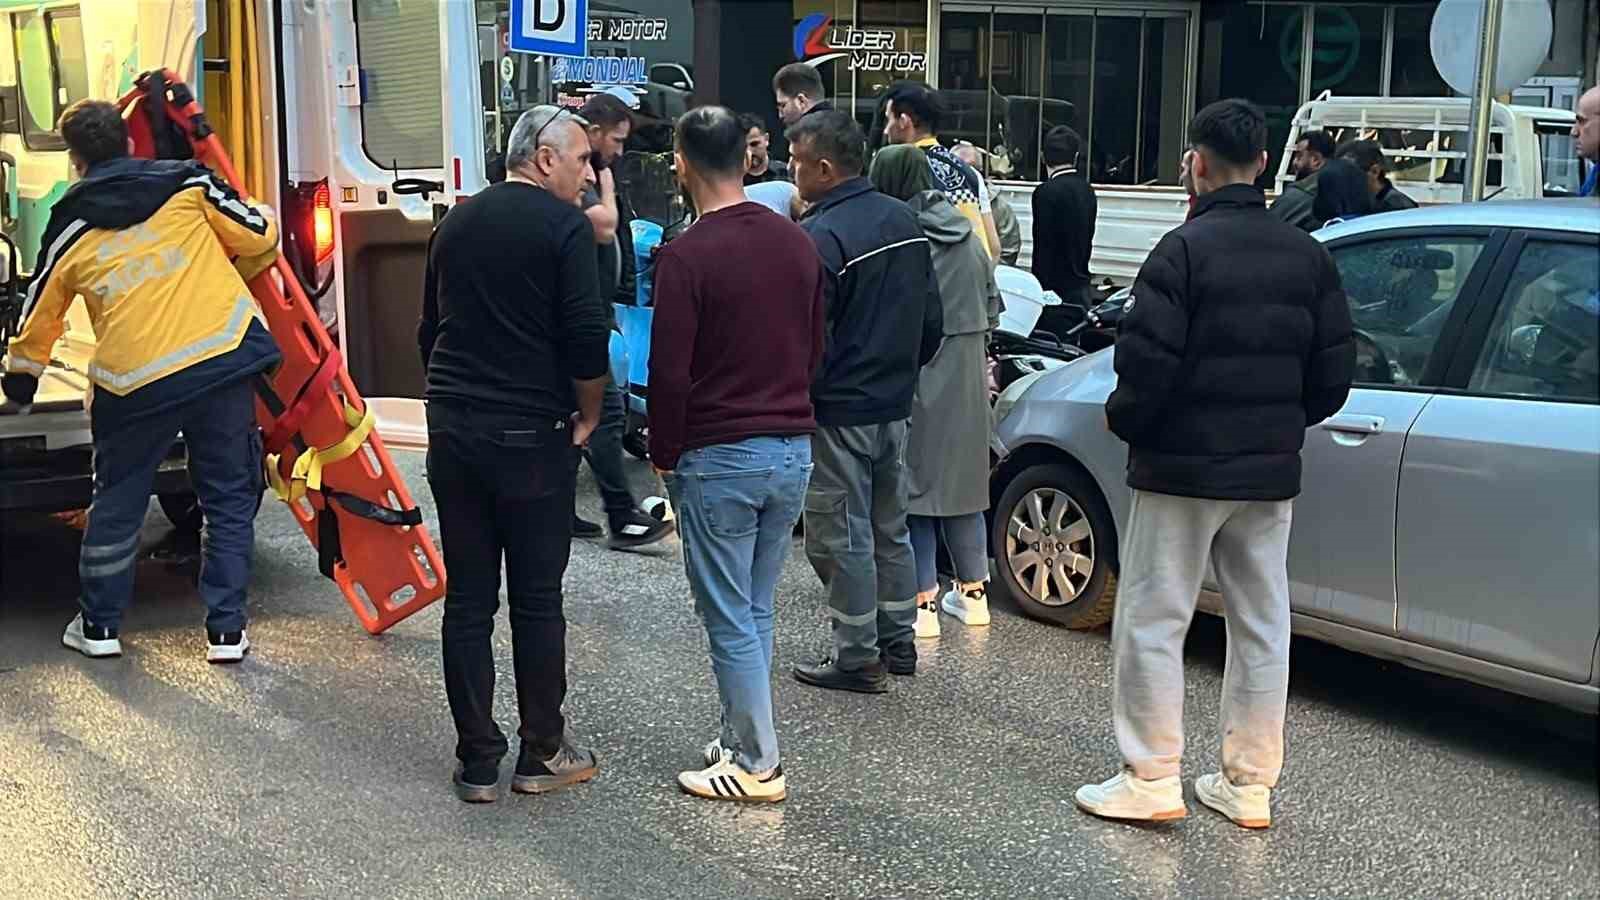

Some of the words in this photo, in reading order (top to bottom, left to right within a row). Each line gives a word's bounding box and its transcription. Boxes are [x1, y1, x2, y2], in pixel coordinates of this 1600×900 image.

[533, 0, 566, 32] D
[608, 18, 667, 40] MOTOR
[828, 25, 896, 49] LİDER
[566, 56, 648, 84] MONDIAL
[848, 50, 927, 71] MOTOR
